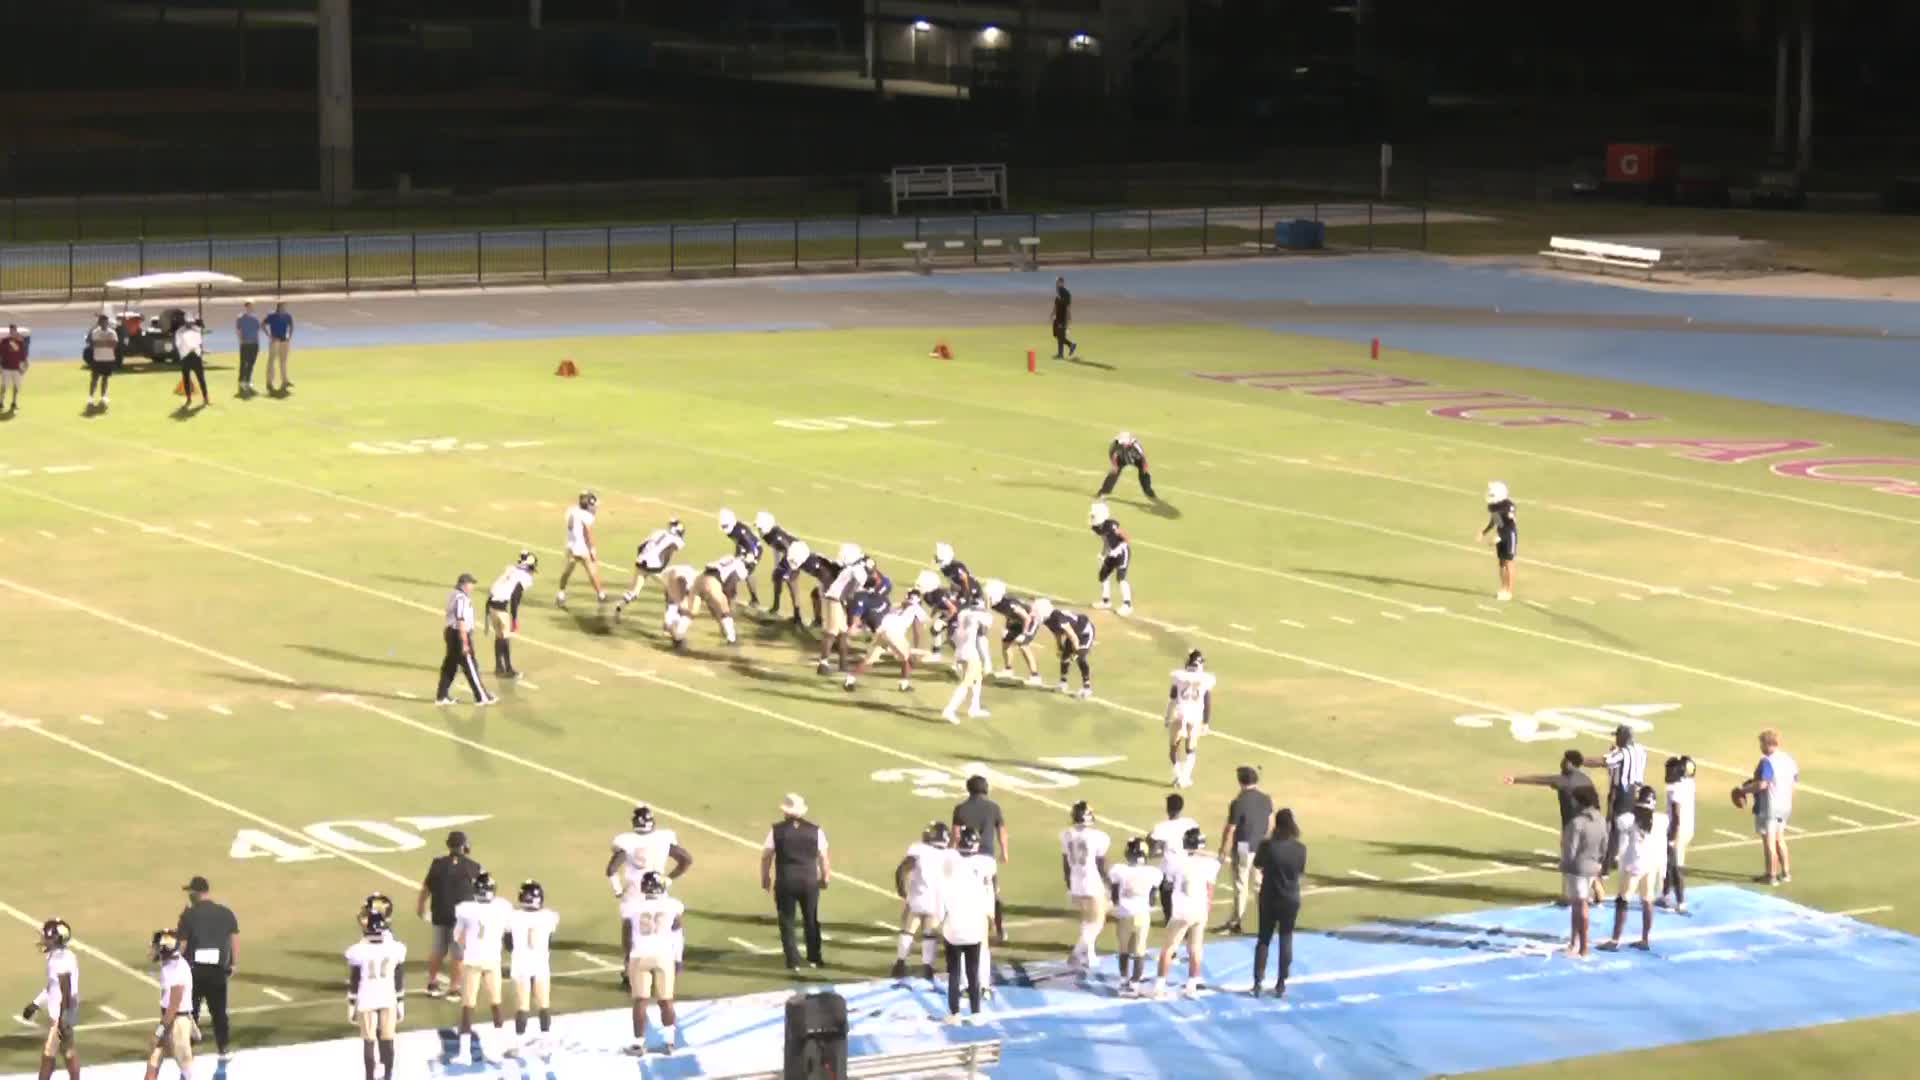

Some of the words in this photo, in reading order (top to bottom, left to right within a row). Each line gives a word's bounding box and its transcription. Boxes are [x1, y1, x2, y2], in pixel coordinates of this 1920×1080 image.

[1453, 707, 1655, 742] 20
[871, 762, 1080, 799] 30
[230, 819, 427, 862] 40
